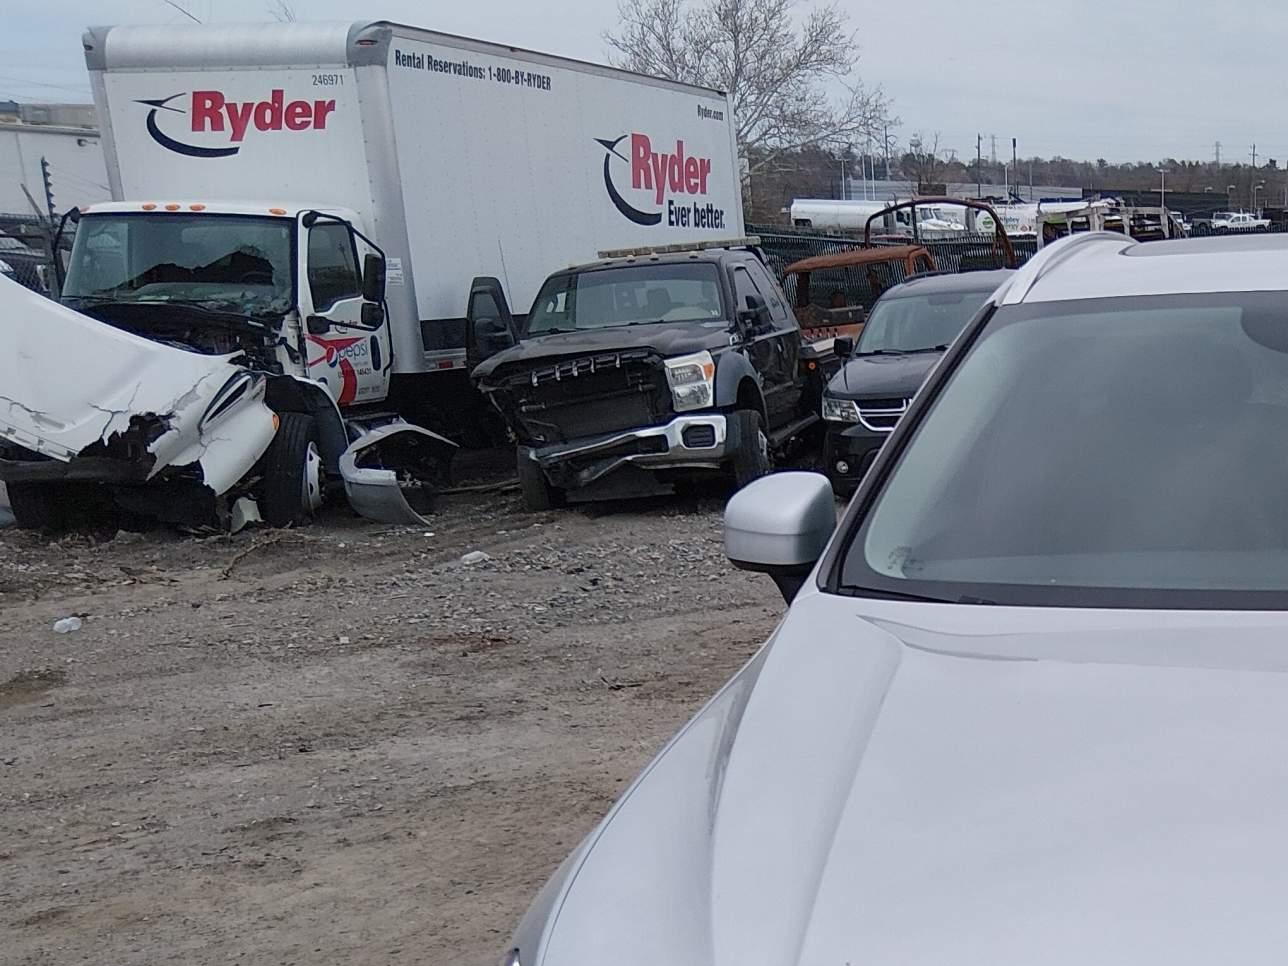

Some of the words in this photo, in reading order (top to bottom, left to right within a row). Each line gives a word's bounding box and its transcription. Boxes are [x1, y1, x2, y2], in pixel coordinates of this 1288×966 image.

[312, 74, 344, 86] 246971
[395, 50, 424, 69] Rental
[428, 55, 486, 80] Reservations:
[488, 66, 552, 91] 1-800-BY-RYDER
[192, 89, 336, 142] Ryder
[697, 104, 724, 121] Ryder.com
[631, 133, 711, 205] Ryder
[668, 199, 691, 227] Ever
[694, 202, 726, 229] better.
